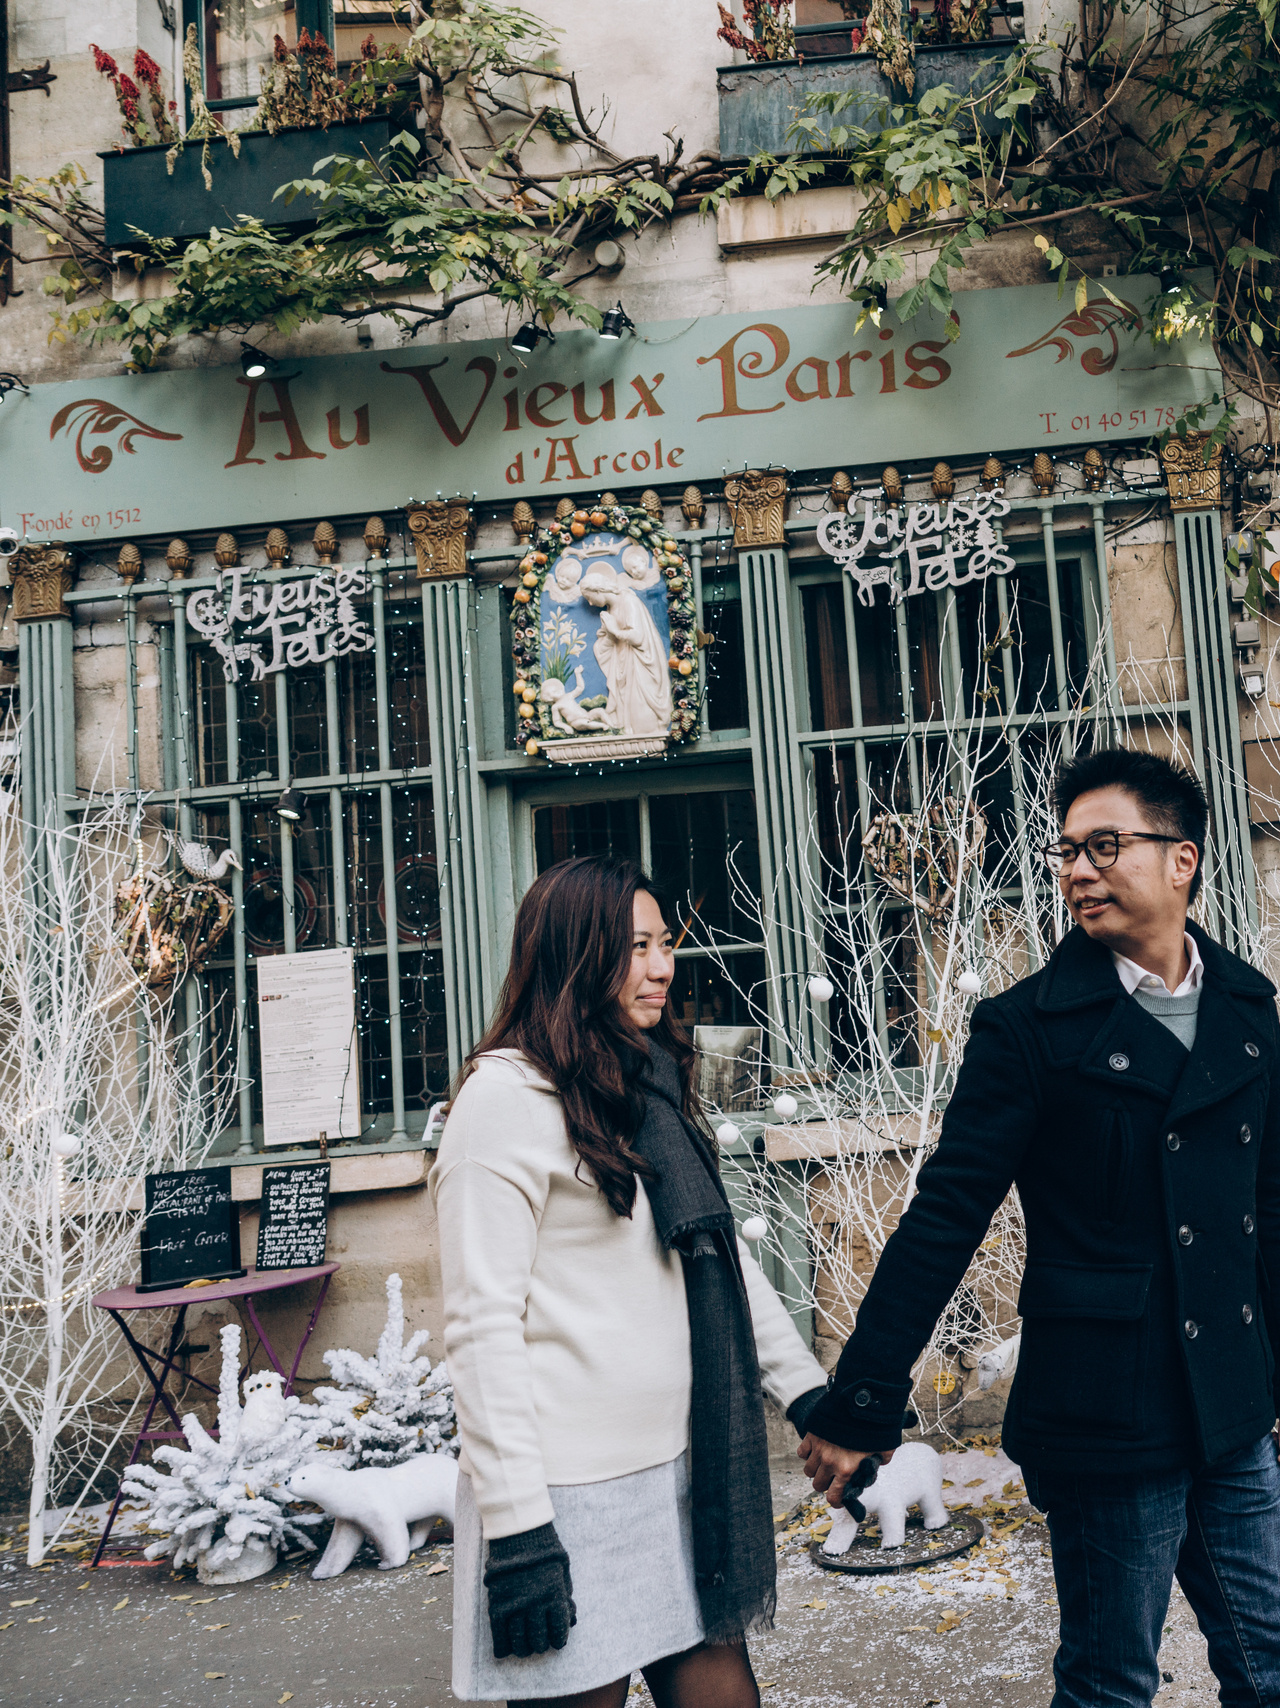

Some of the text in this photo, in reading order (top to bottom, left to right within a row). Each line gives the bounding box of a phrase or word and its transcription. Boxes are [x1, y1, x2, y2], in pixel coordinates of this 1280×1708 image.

[224, 309, 961, 469] Au Vieux Paris
[1038, 412, 1060, 434] T.
[1071, 414, 1091, 431] 01
[1098, 412, 1123, 432] 40
[1128, 409, 1147, 431] 51
[1154, 406, 1176, 427] 78
[505, 434, 685, 485] d'Arcole
[16, 508, 142, 541] Fondé en 1512
[816, 487, 1012, 559] Joyeuses
[186, 566, 373, 635] Joyeuses
